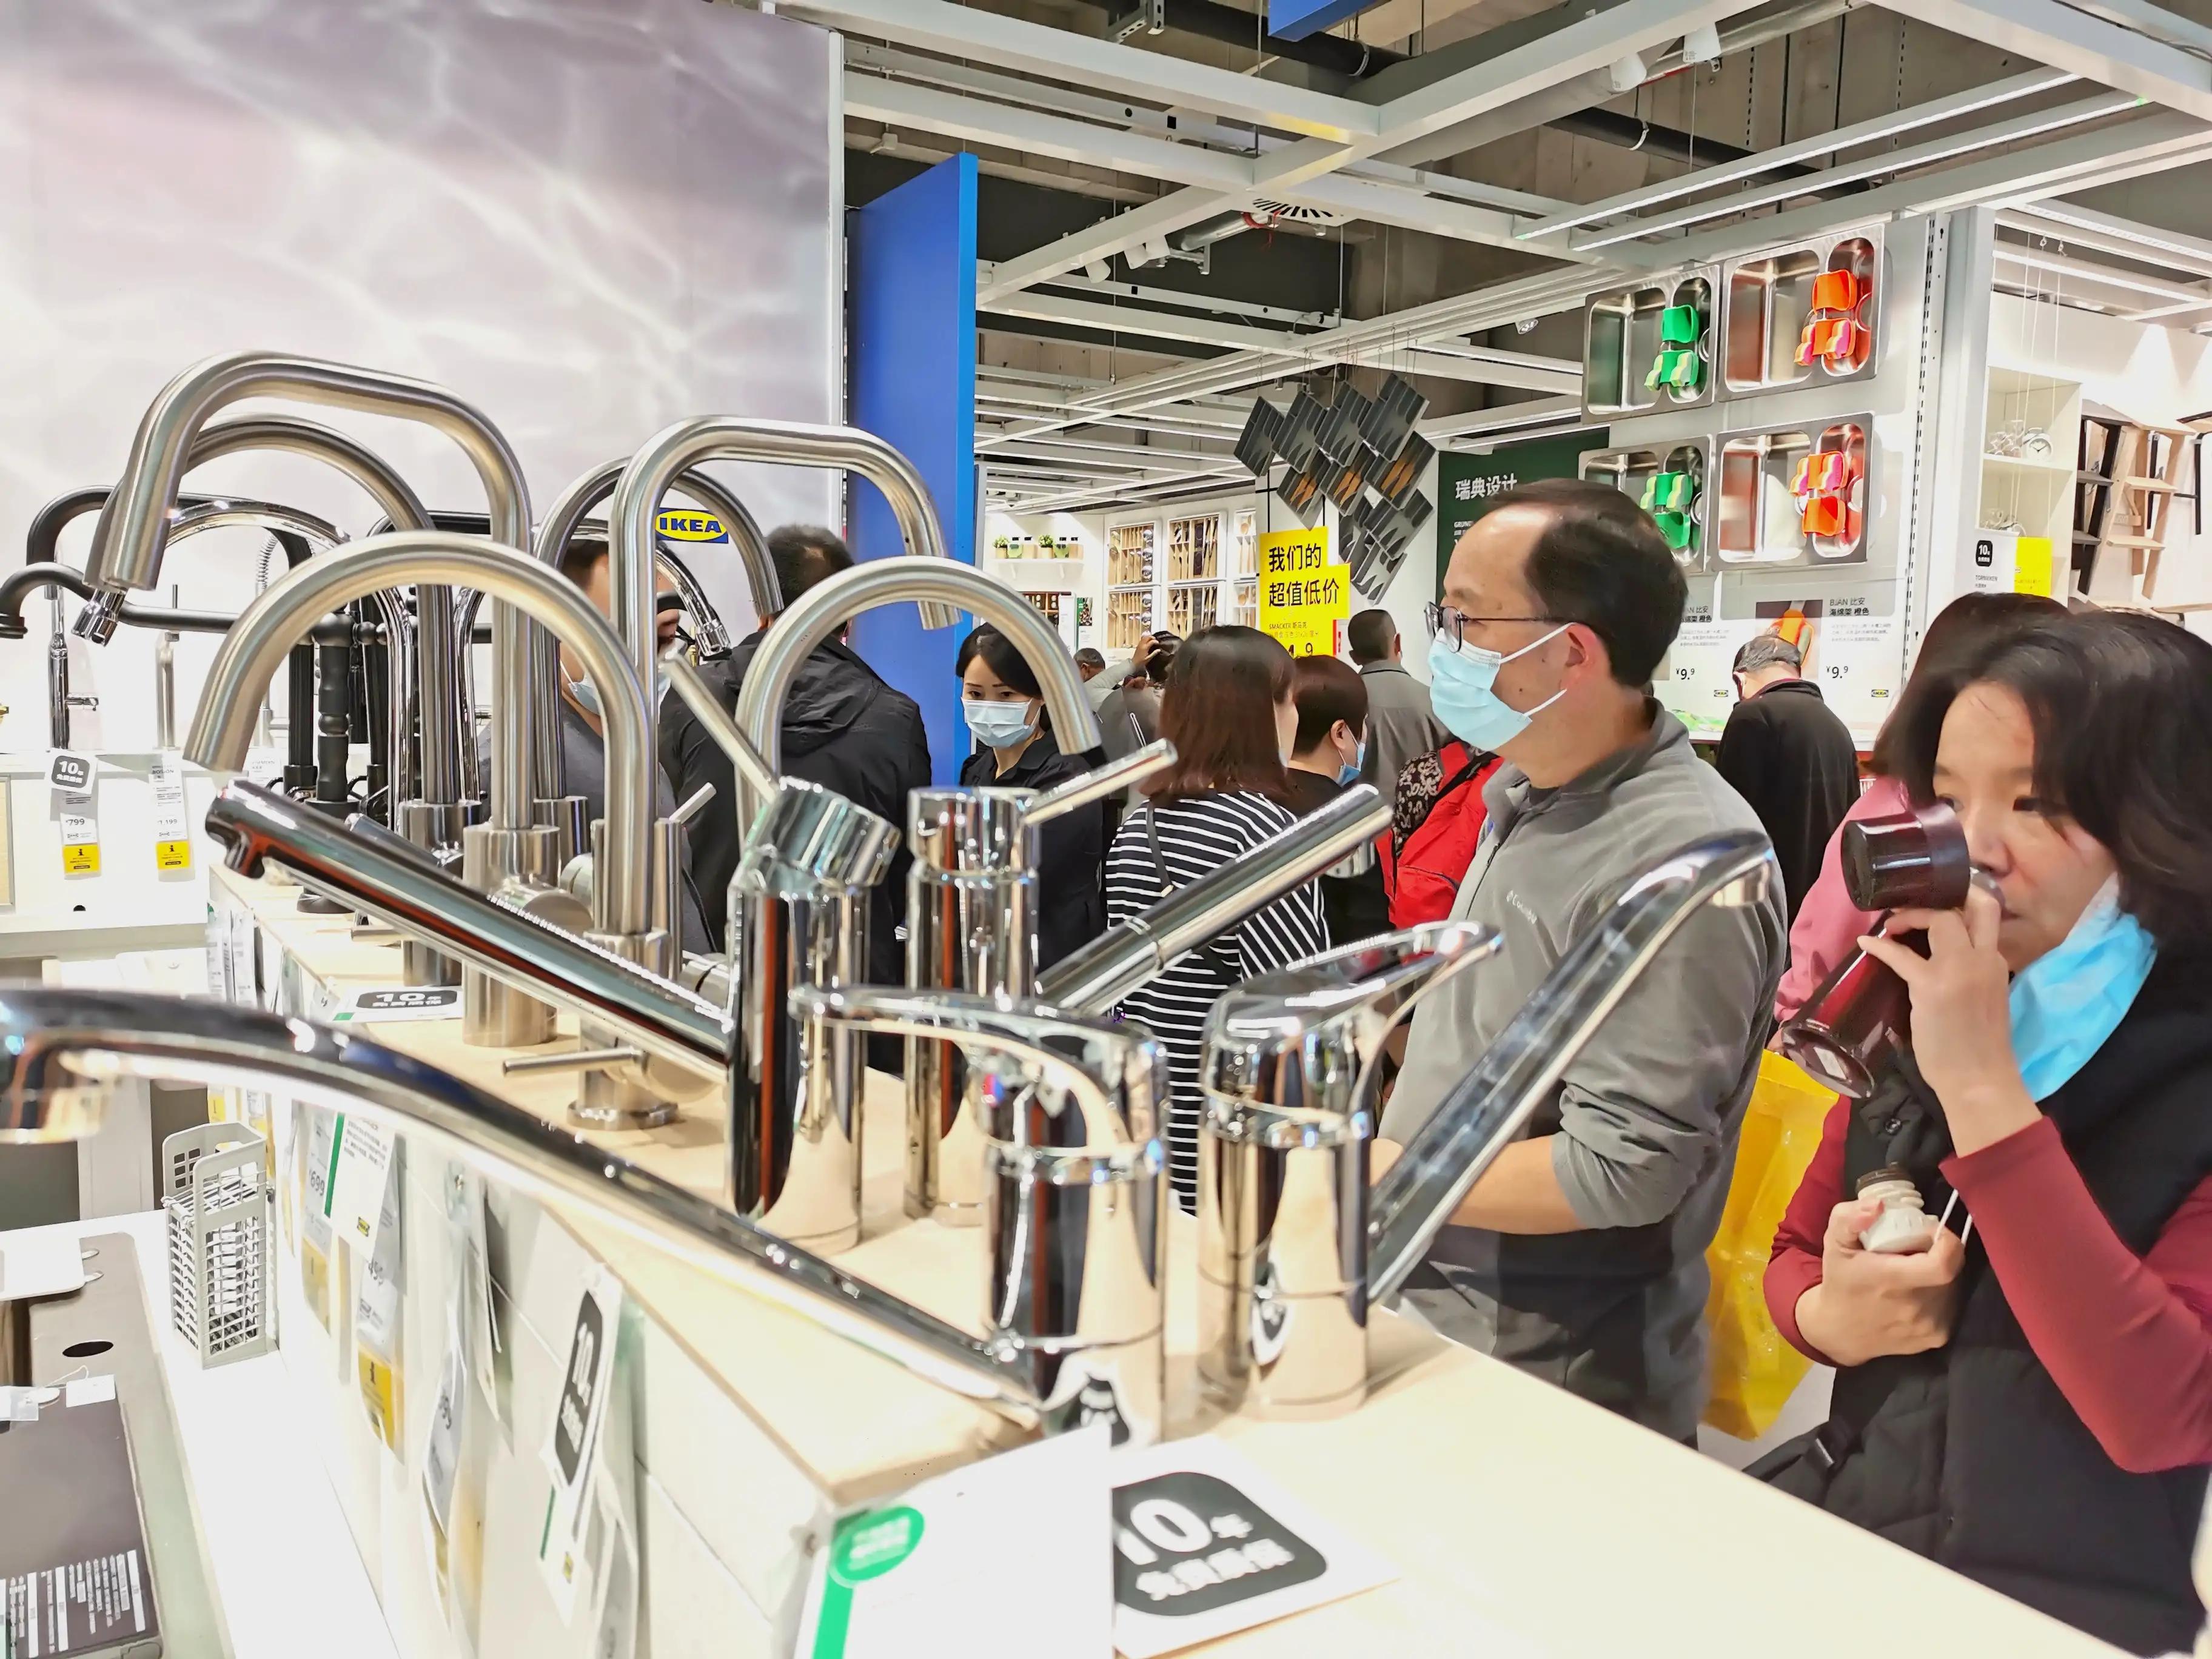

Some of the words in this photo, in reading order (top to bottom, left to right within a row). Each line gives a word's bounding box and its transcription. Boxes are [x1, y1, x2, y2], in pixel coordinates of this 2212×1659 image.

[1455, 473, 1517, 500] 瑞典设计
[659, 517, 722, 533] IKEA
[1269, 543, 1321, 572] 我们的
[1269, 578, 1339, 607] 超值低价
